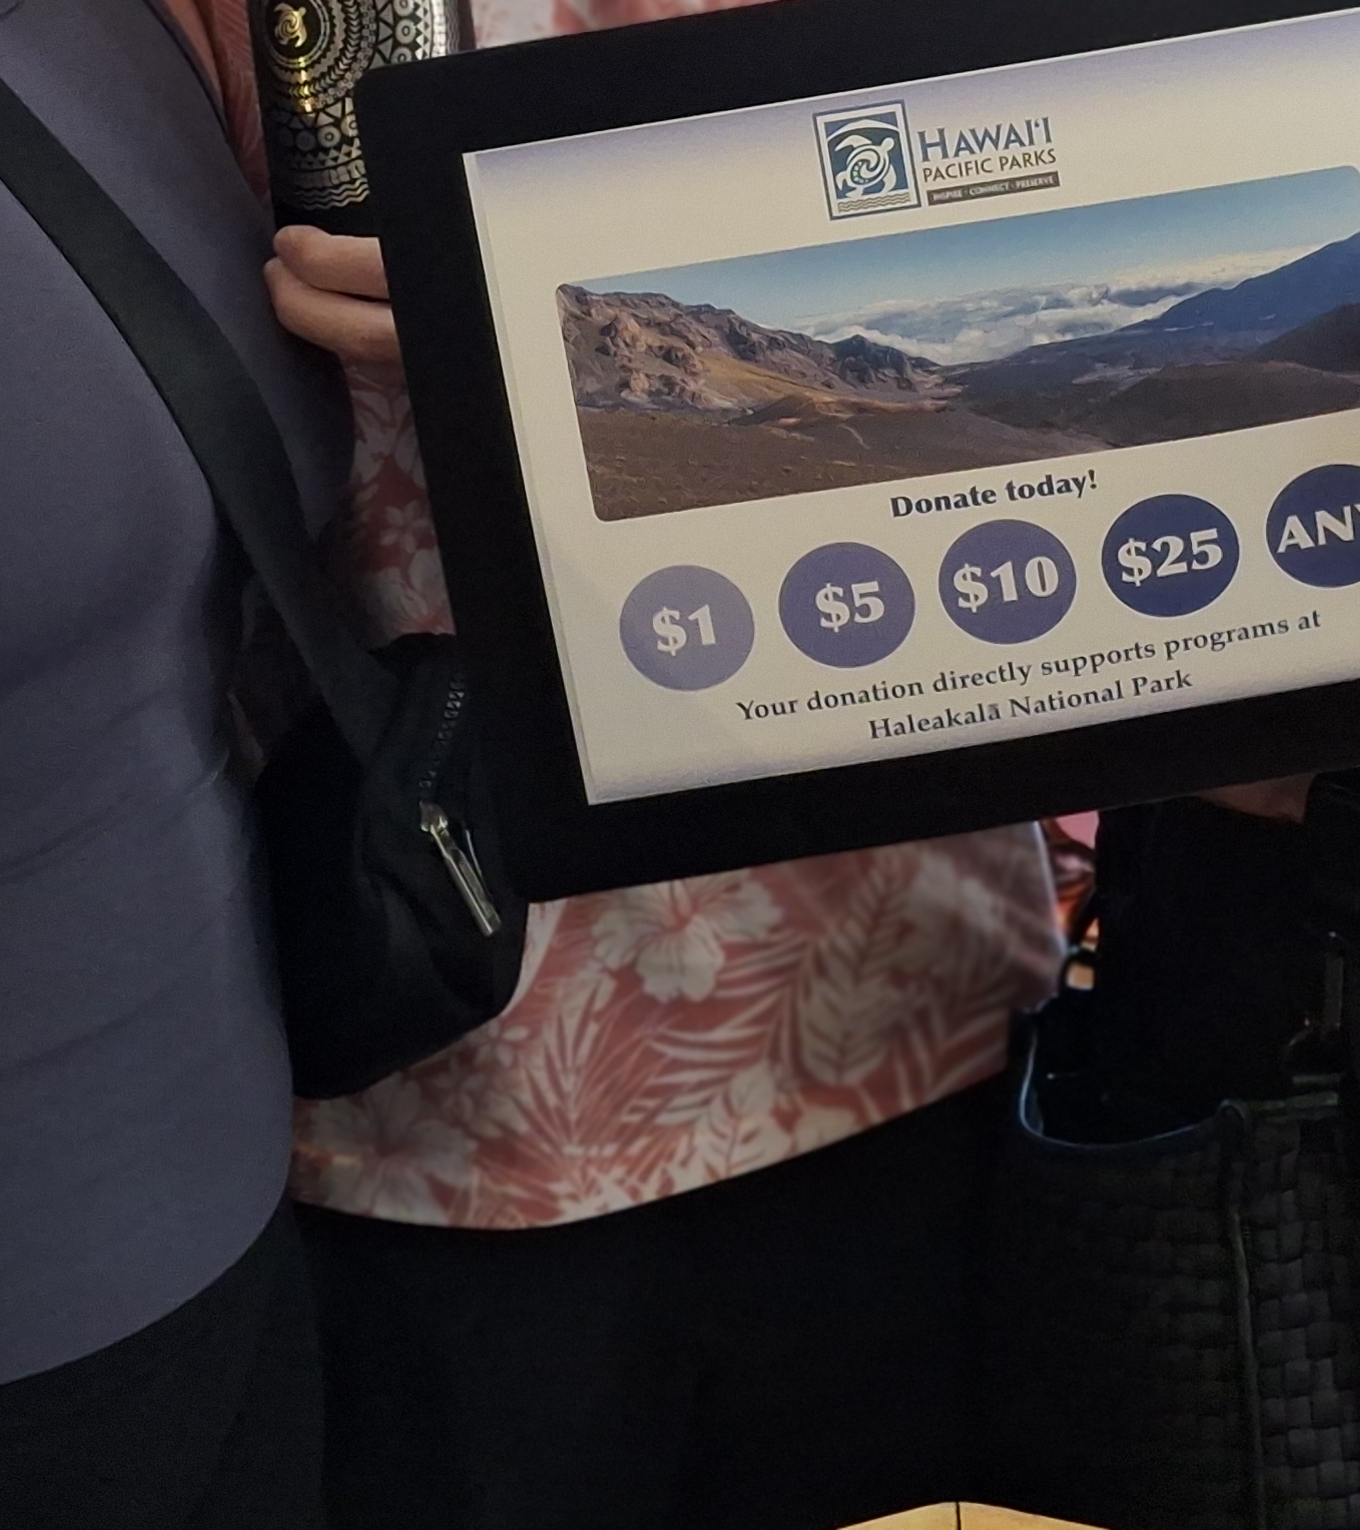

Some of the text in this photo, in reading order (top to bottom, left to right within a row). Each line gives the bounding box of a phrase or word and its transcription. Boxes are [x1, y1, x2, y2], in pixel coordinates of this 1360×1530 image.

[923, 149, 1057, 183] PACIFIC PARKS
[890, 469, 1097, 518] Donate today!
[652, 605, 716, 657] $1
[815, 580, 885, 633] $5
[952, 556, 1060, 614] $10
[1116, 527, 1224, 587] $25
[736, 609, 1321, 720] Your donation directly supports programs at
[868, 669, 1193, 740] Haleakalā National Park
